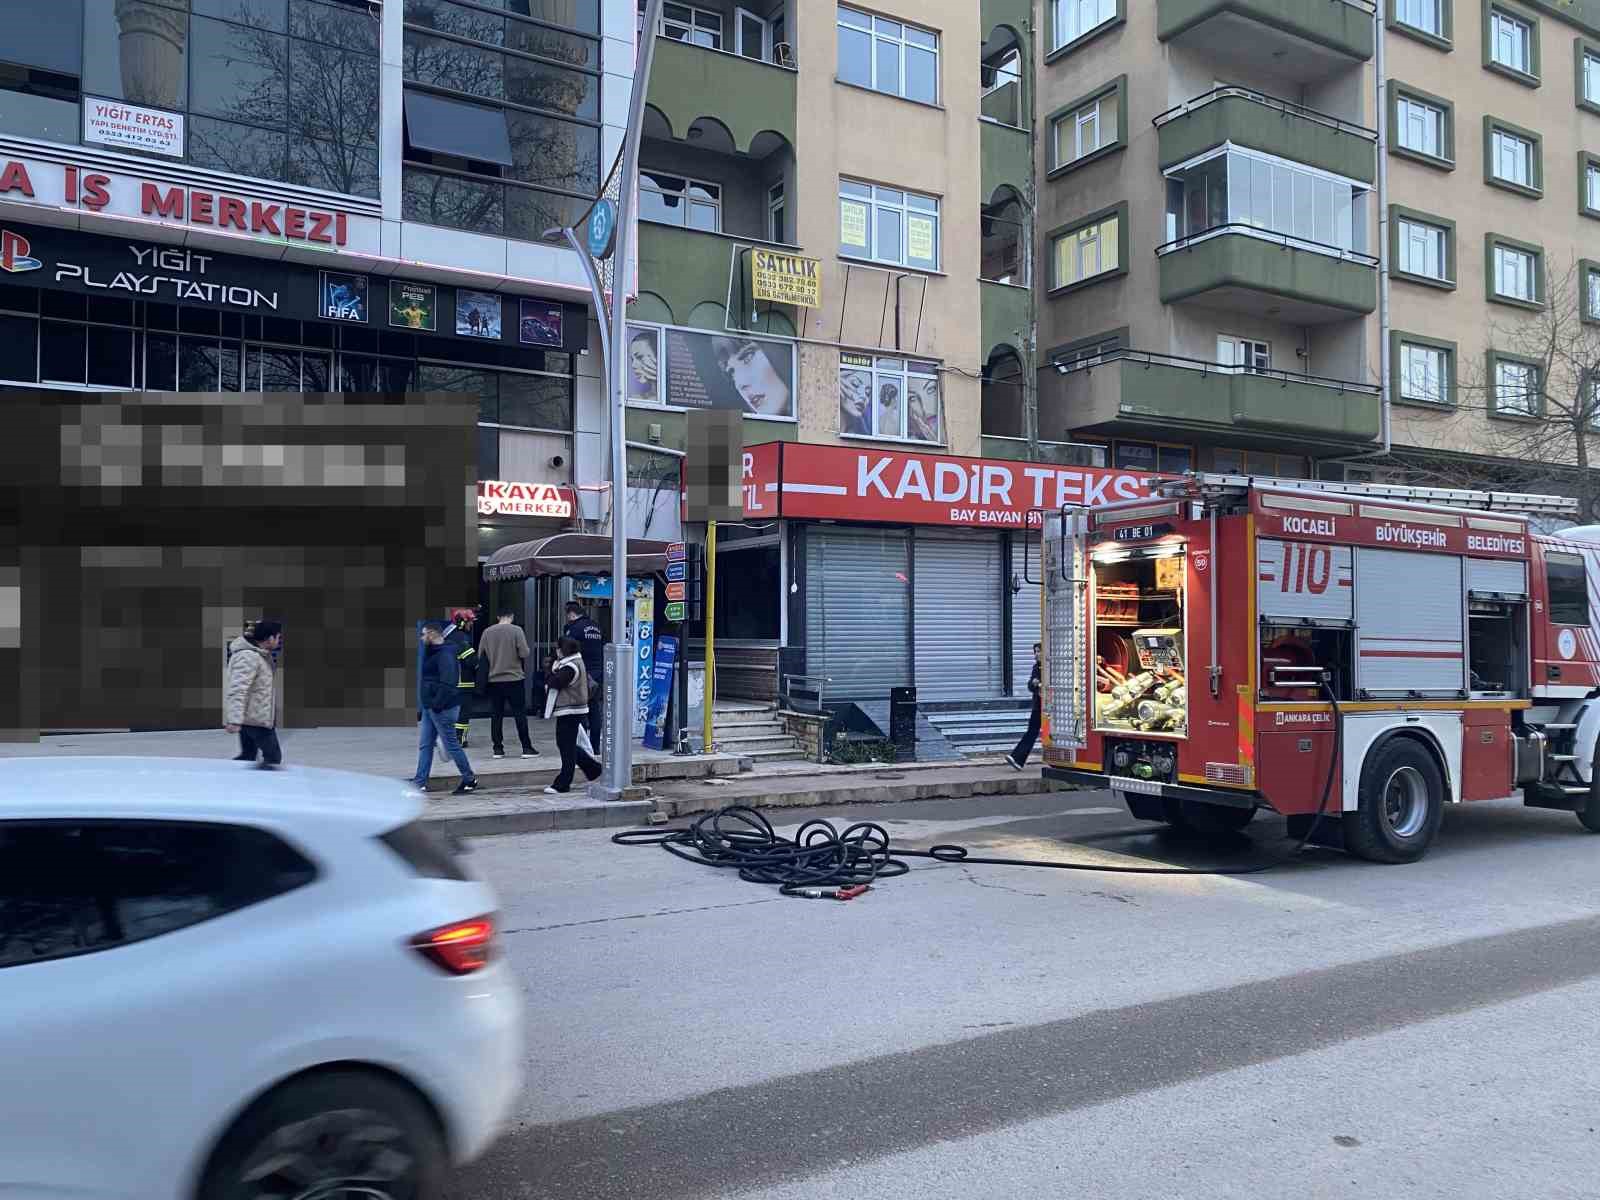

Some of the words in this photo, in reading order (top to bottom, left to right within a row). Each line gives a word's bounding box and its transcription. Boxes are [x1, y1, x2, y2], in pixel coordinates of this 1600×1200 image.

[64, 165, 111, 212] İŞ
[141, 182, 348, 246] MERKEZİ
[756, 252, 817, 278] SATILIK
[56, 262, 278, 310] PLAYSTATION
[328, 305, 360, 320] FIFA
[488, 484, 558, 501] KAYA
[500, 502, 568, 515] MERKEZİ
[950, 508, 977, 521] BAY
[979, 510, 1021, 523] BAYAN
[1283, 516, 1336, 537] KOCAELİ
[1376, 522, 1447, 548] BÜYÜKŞEHİR
[1467, 534, 1525, 554] BELEDİYESİ
[1281, 543, 1331, 595] 110
[1285, 712, 1311, 723] ANKARA
